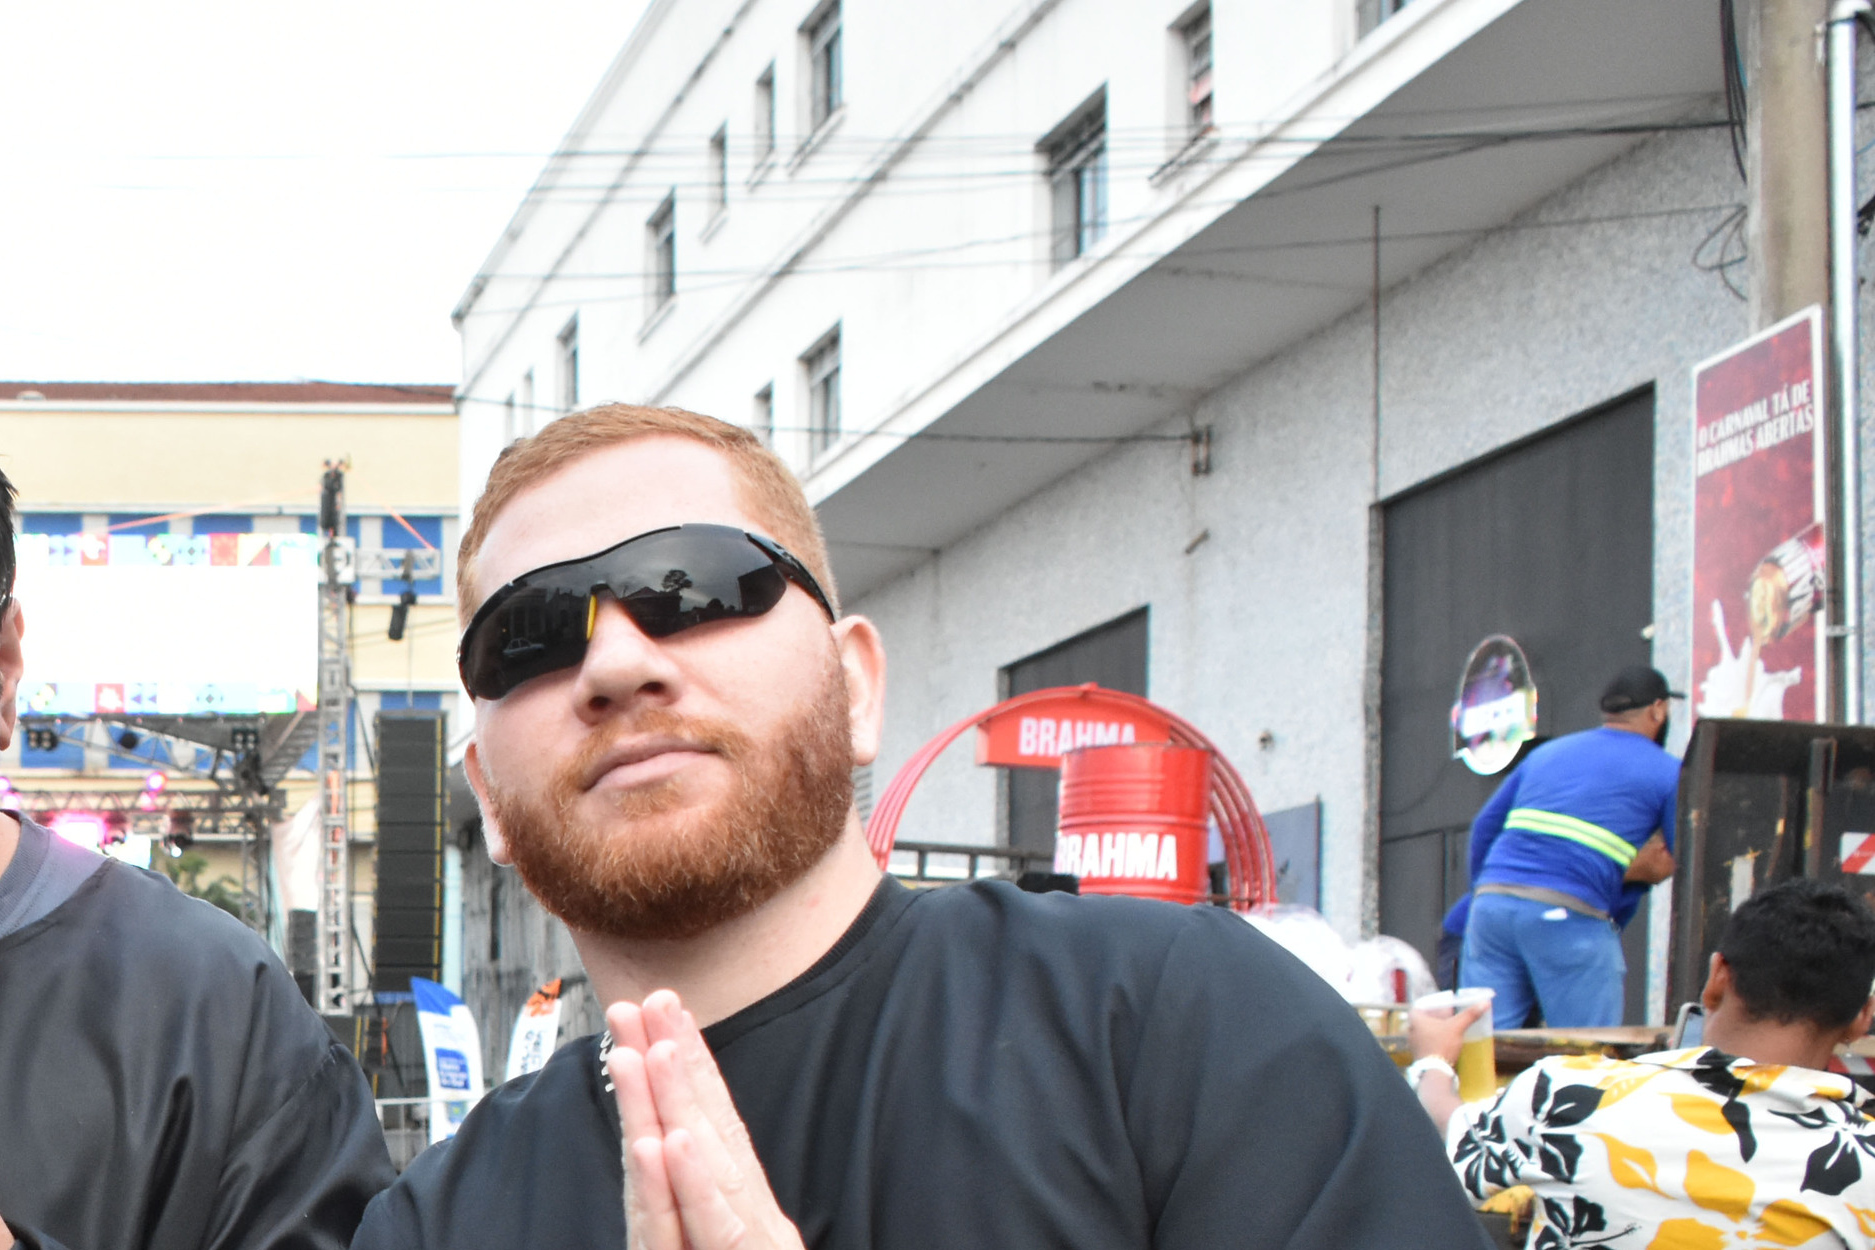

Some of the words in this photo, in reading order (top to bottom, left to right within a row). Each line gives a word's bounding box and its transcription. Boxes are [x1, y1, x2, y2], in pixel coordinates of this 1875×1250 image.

[1697, 430, 1754, 477] BRAHMAS
[1755, 403, 1813, 450] ABERTAS
[1699, 426, 1708, 449] O
[1710, 398, 1768, 444] CARNAVAL
[1772, 382, 1789, 416] TÁ
[1792, 380, 1810, 408] DE
[1019, 716, 1135, 757] BRAHMA
